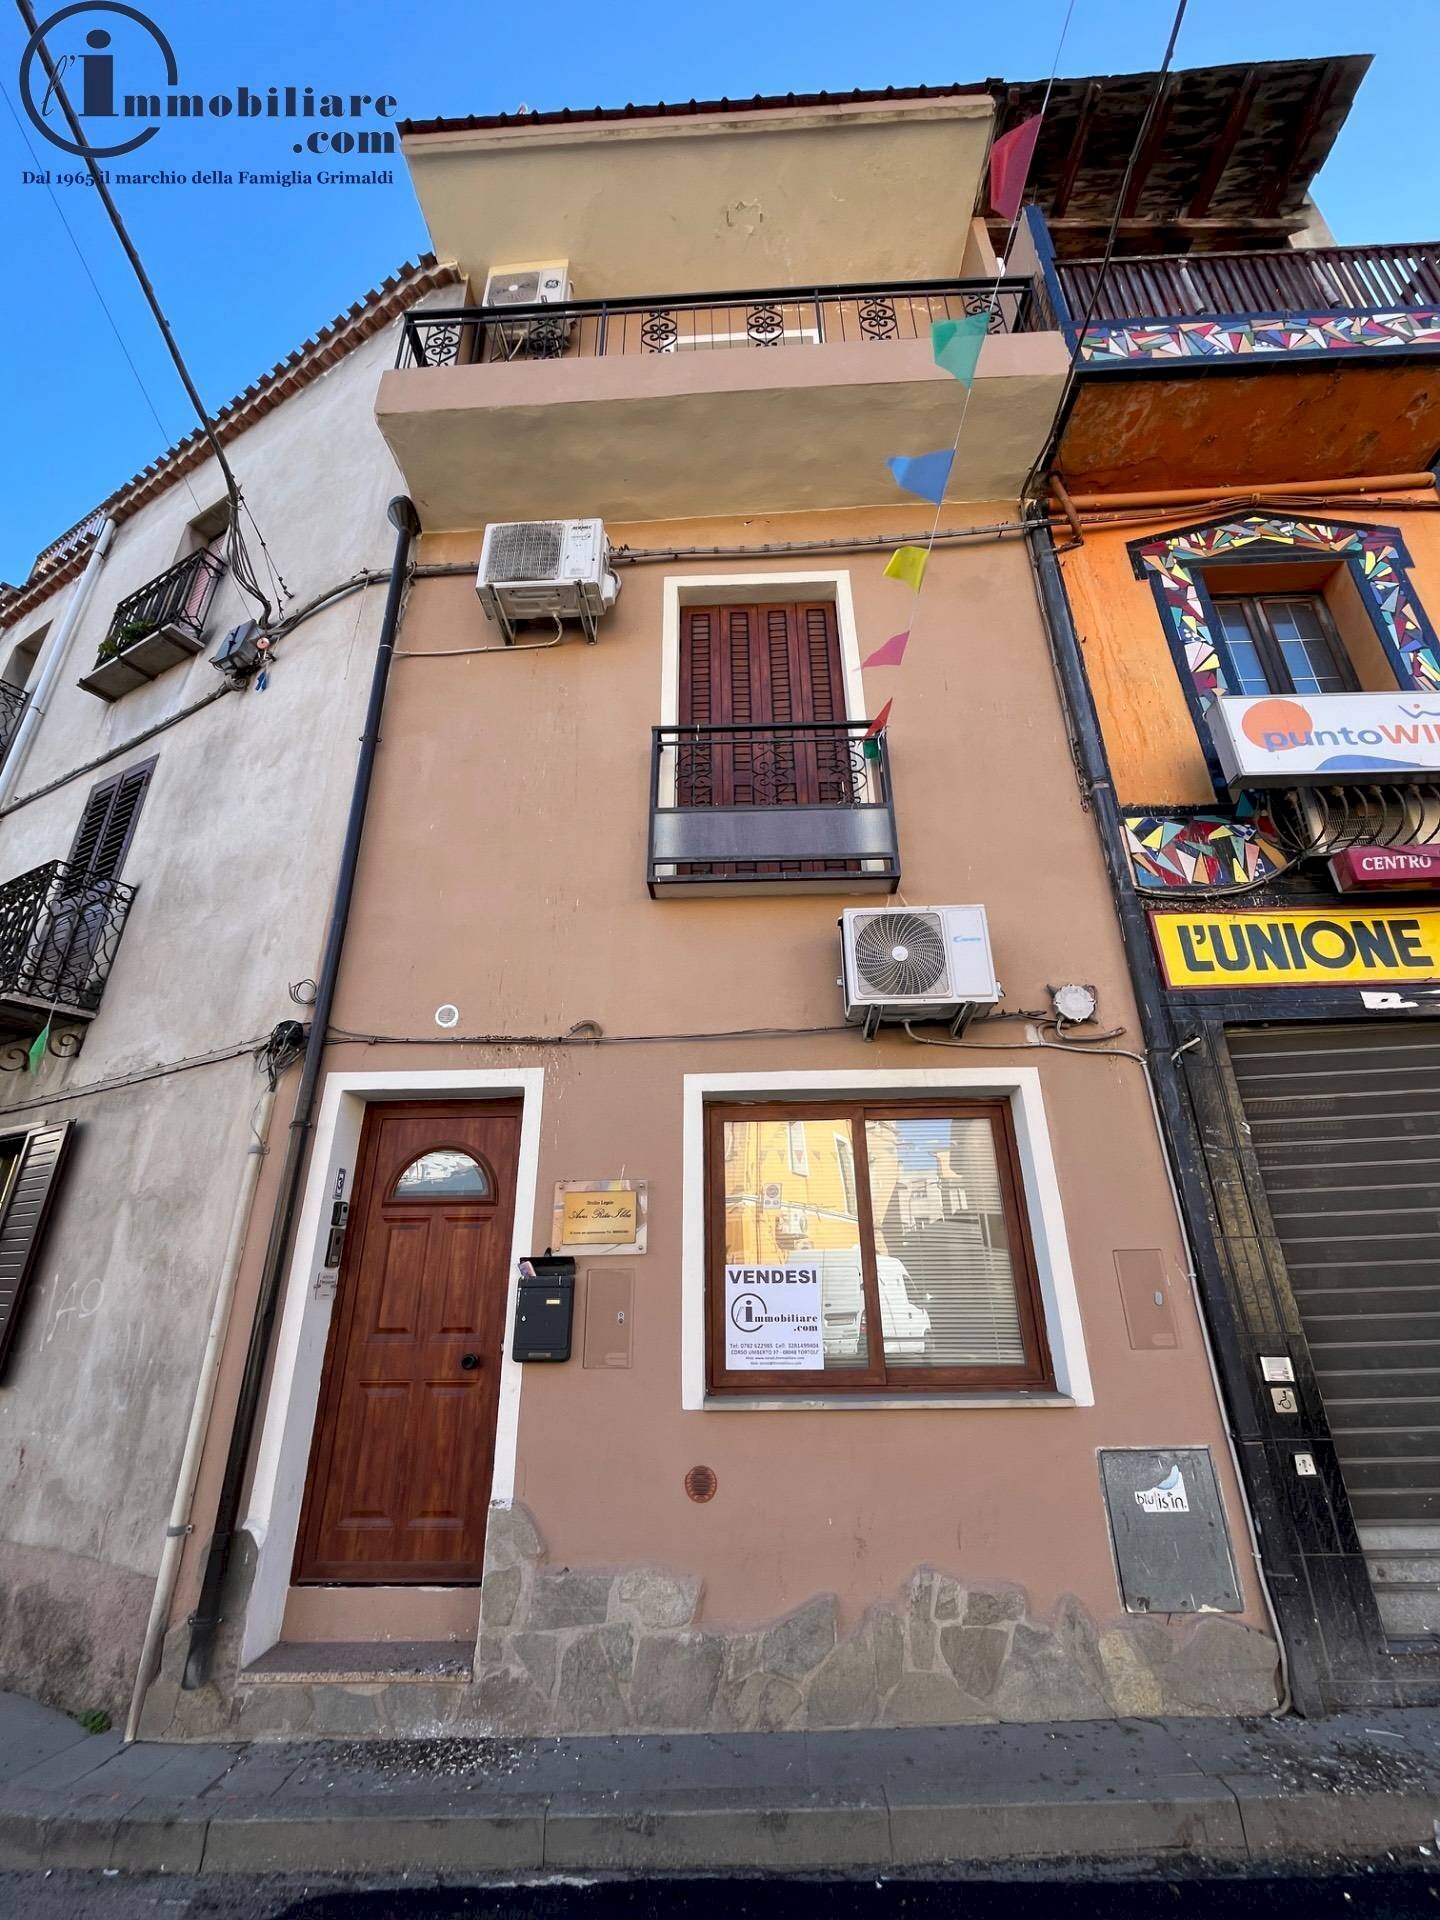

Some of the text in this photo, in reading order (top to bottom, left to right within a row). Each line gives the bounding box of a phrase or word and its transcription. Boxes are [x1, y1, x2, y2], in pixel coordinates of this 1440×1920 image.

[1263, 724, 1440, 753] puntoWI
[1362, 854, 1432, 872] CENTRO
[1176, 919, 1435, 972] L'UNIONE
[728, 1269, 817, 1284] VENDESI
